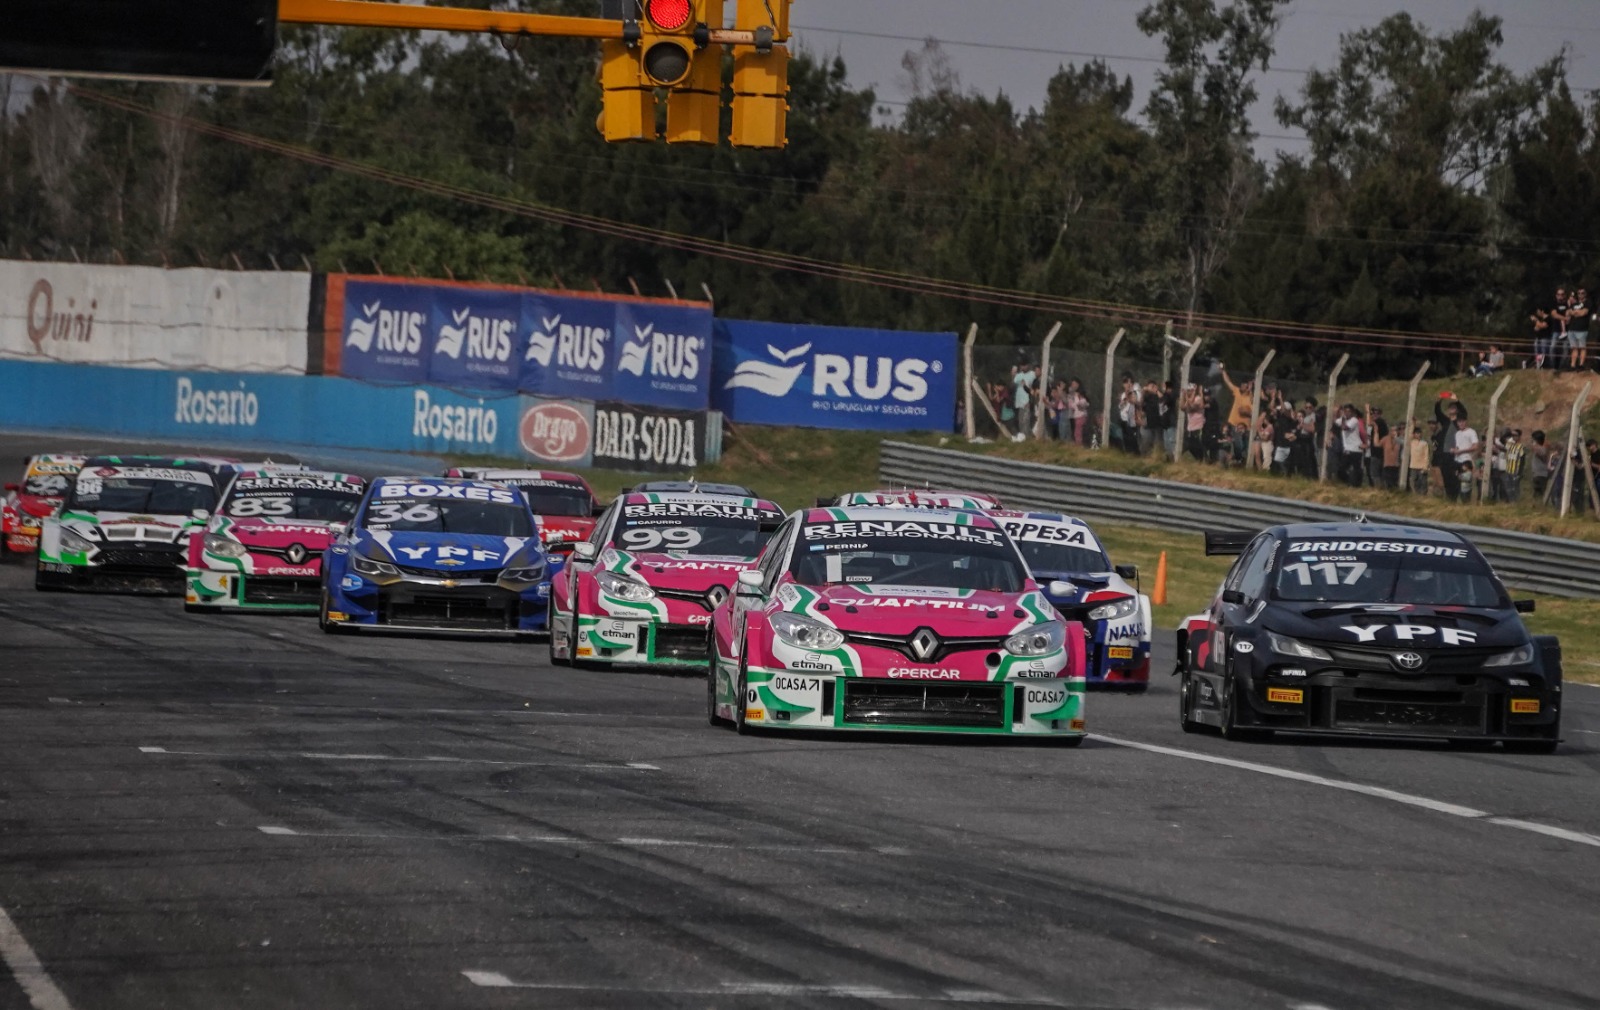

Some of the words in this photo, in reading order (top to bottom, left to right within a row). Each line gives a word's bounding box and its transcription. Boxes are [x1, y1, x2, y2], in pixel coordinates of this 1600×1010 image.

[27, 279, 97, 354] Quini
[175, 377, 259, 427] Rosario
[833, 402, 879, 413] URUGUAY
[882, 405, 928, 416] SEGUROS
[413, 389, 497, 443] Rosario
[532, 411, 577, 455] Drago
[236, 478, 363, 491] RENAULT
[380, 484, 514, 504] BOXES
[230, 497, 293, 516] 83
[367, 504, 438, 523] 36
[624, 503, 781, 518] RENAULT
[621, 526, 702, 550] 99
[804, 521, 1003, 541] RENAULT
[805, 531, 1004, 547] CONCESIONARIOS
[397, 545, 501, 562] YPF
[1288, 541, 1469, 558] BRIDGESTONE
[1283, 562, 1368, 586] 117
[829, 598, 1005, 613] QUANTIUM
[1340, 624, 1477, 645] YPF
[1271, 690, 1301, 702] PIRELLI
